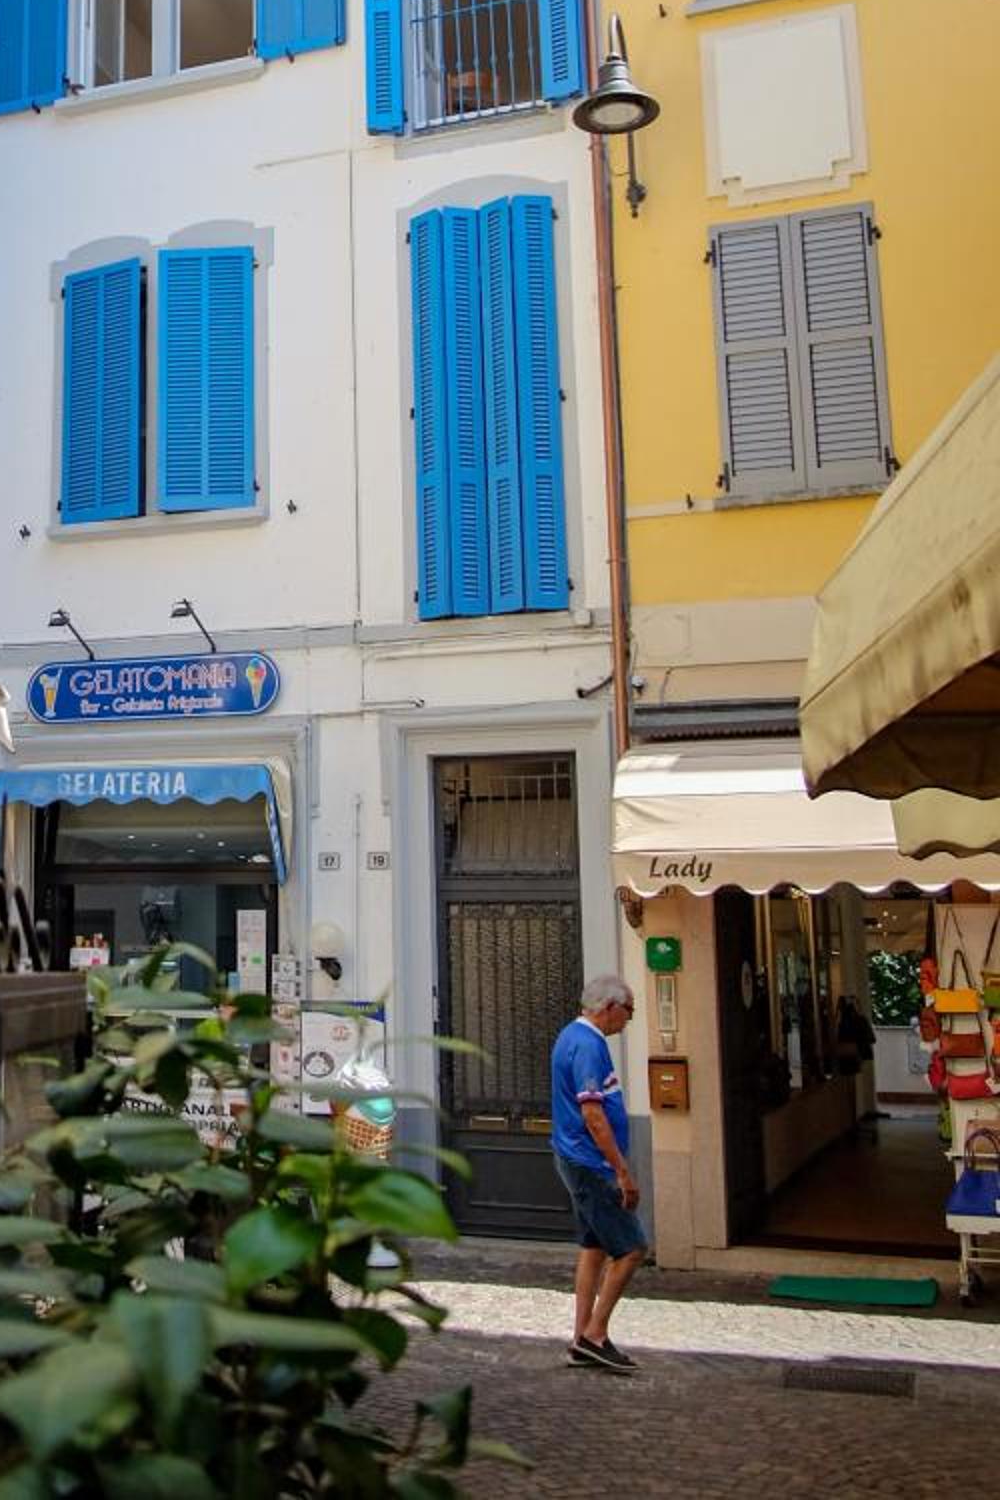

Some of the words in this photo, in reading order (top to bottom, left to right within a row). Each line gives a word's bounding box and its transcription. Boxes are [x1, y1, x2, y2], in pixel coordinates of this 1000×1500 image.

[69, 661, 238, 697] GELATOMANIA
[56, 771, 187, 797] GELATERIA
[648, 854, 713, 883] Lady
